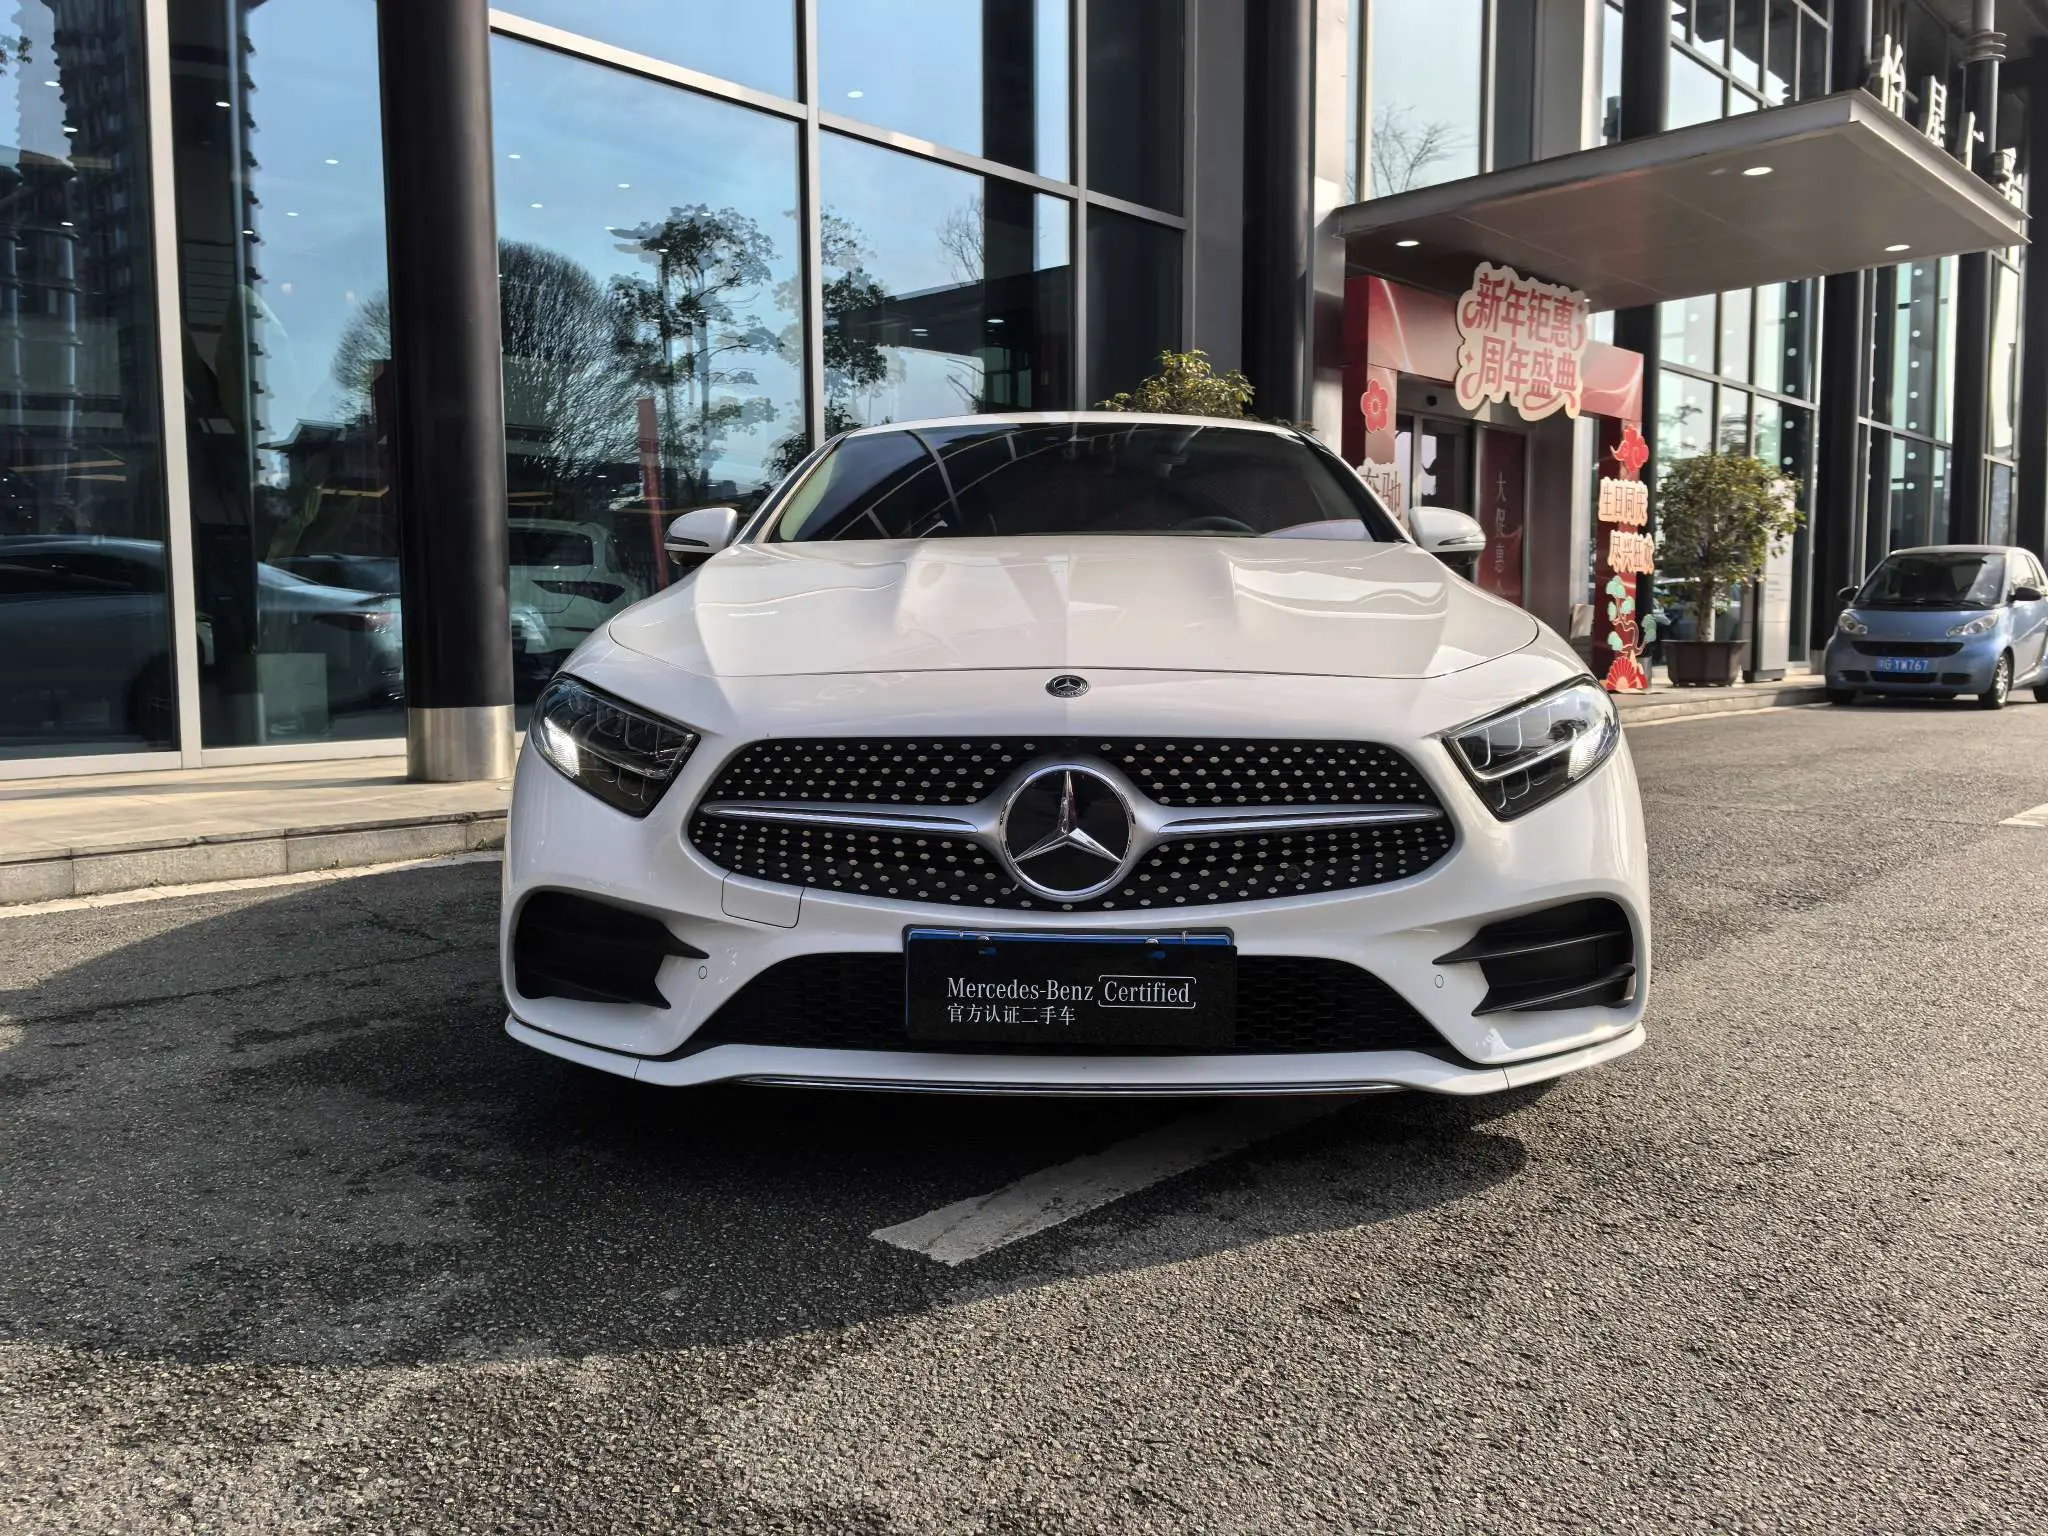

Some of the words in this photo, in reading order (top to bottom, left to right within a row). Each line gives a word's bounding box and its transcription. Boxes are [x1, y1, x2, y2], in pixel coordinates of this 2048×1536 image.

[1463, 273, 1584, 351] 新年钜惠
[1461, 335, 1577, 411] 周年盛典
[1600, 482, 1646, 521] 生日同庆
[947, 977, 1094, 1001] Mercedes-Benz
[1104, 981, 1190, 1003] Certified
[947, 1003, 1076, 1026] 官方认证二手车
